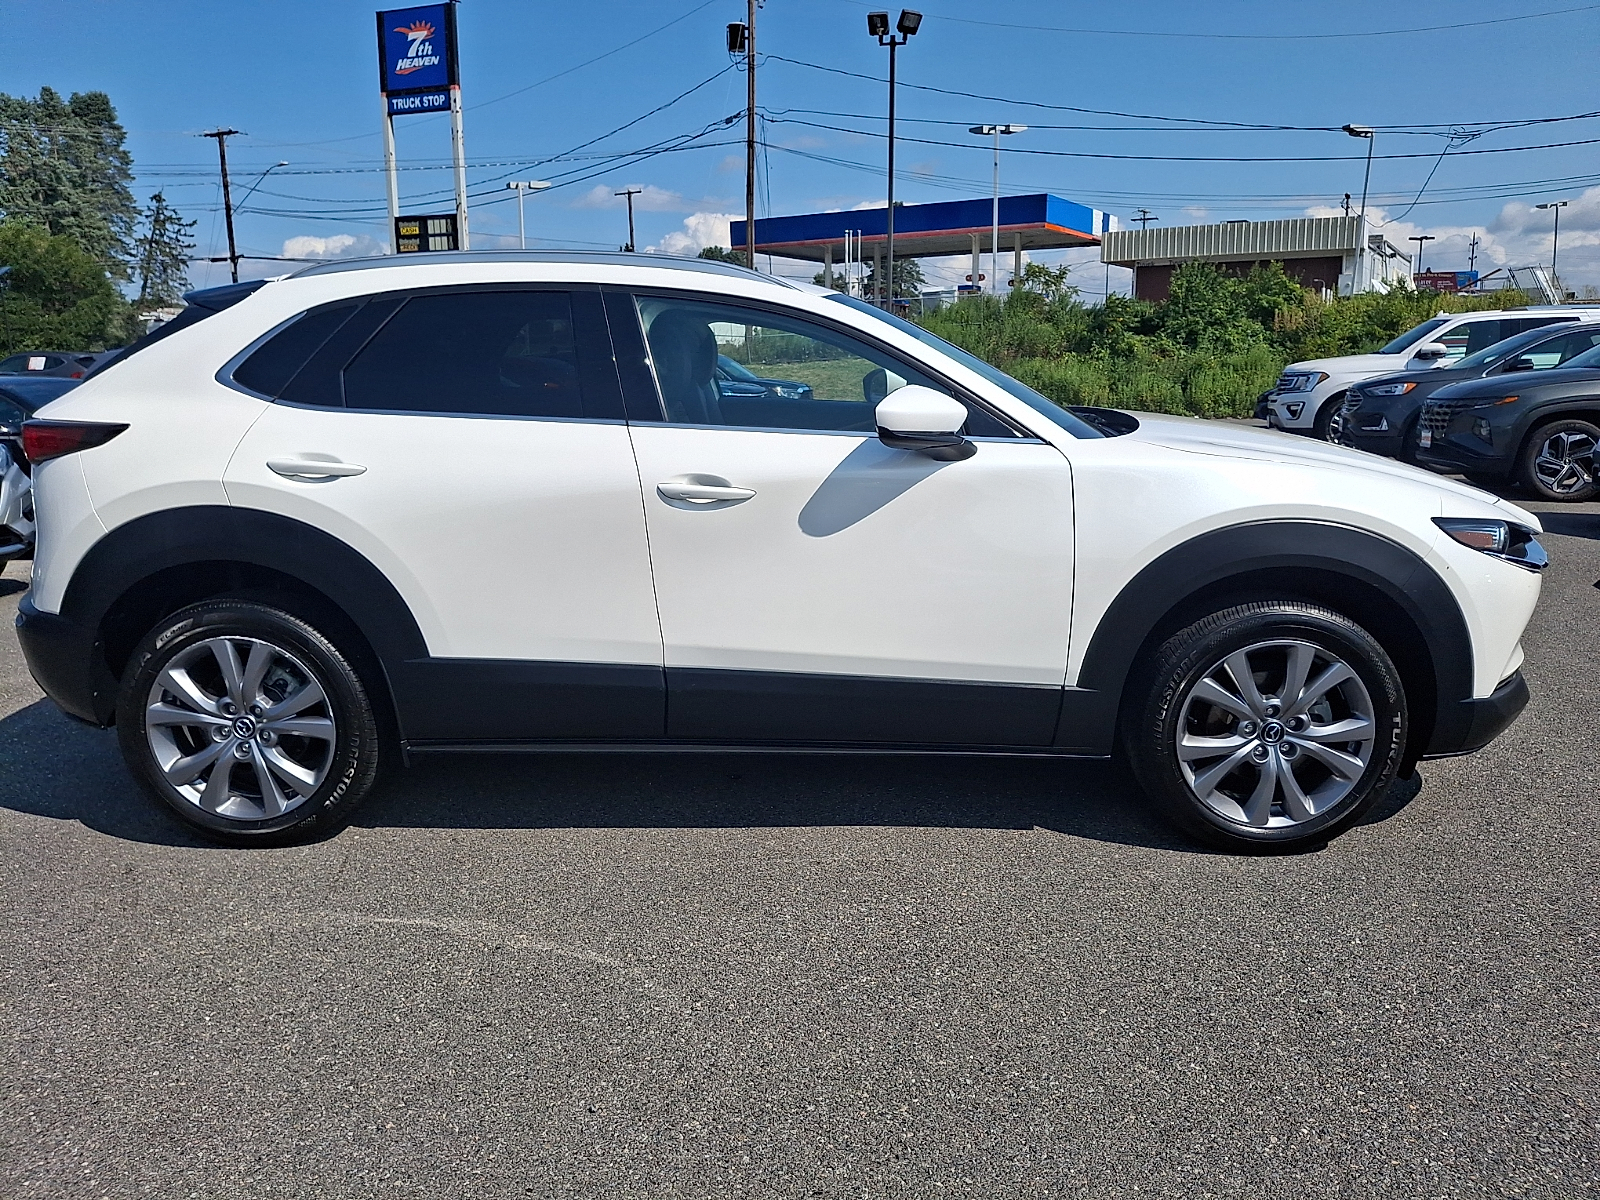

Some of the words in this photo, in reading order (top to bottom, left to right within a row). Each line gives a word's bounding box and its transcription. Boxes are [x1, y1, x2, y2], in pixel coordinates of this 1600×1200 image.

[407, 31, 432, 57] 7th
[396, 56, 440, 70] HEAVEN
[392, 97, 421, 110] TRUCK
[423, 95, 445, 107] STOP
